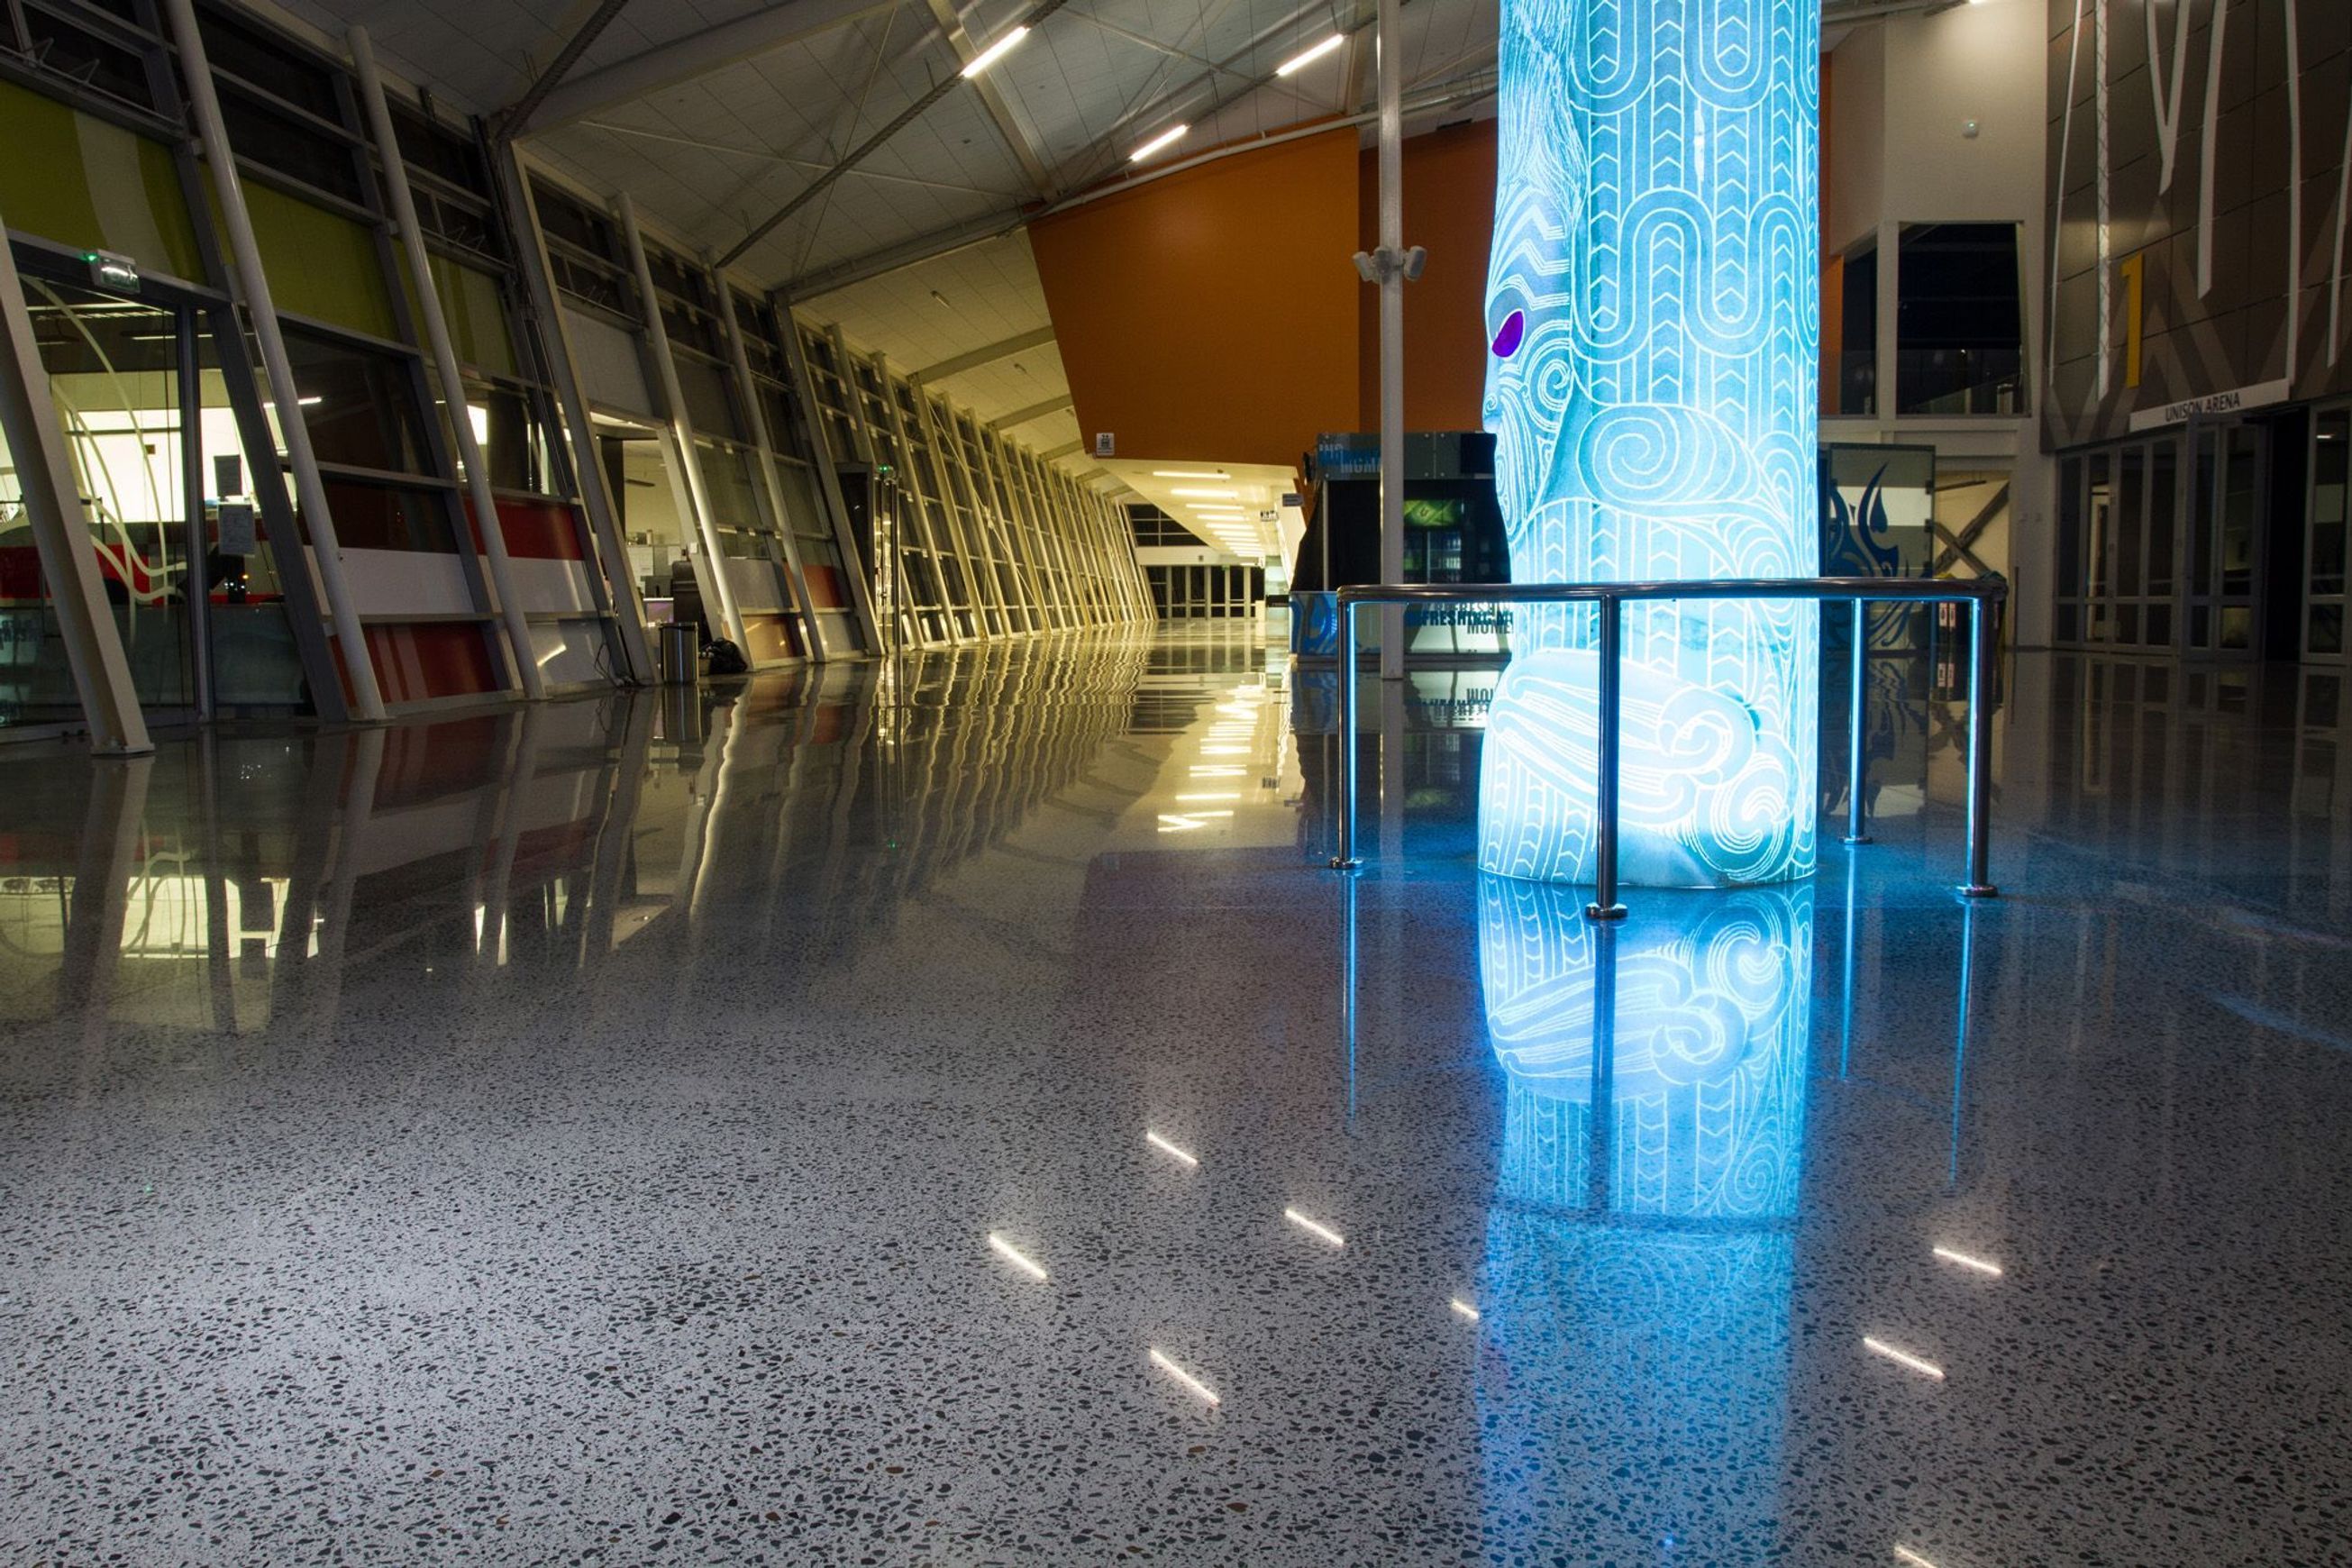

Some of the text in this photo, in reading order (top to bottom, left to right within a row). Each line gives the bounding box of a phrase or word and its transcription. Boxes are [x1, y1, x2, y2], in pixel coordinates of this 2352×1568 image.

[2120, 251, 2145, 389] 1
[2165, 391, 2241, 422] UNISON ARENA
